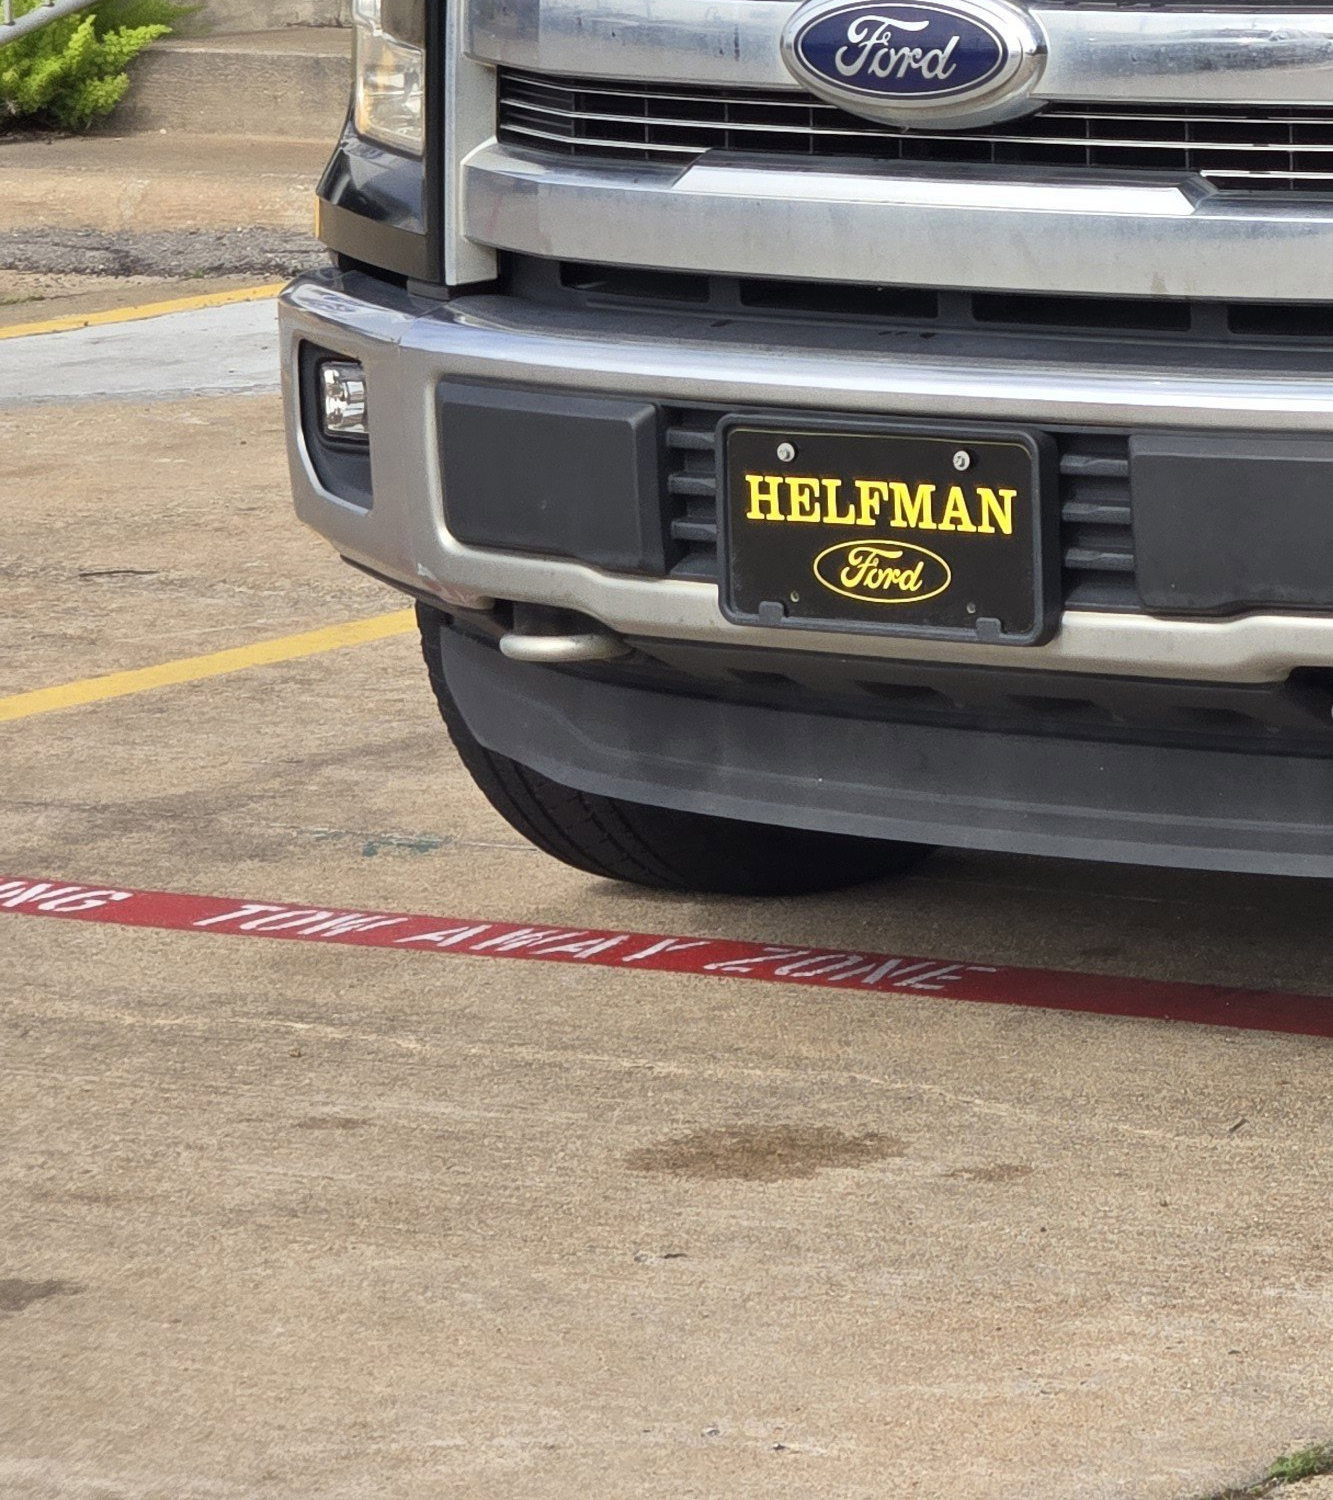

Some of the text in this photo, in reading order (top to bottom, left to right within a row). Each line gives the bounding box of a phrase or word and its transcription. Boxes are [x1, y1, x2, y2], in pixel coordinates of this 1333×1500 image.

[835, 14, 960, 80] Ford
[745, 474, 1017, 535] HELFMAN
[840, 546, 924, 592] Ford
[193, 904, 409, 938] TOW
[395, 923, 711, 963] AWAY
[701, 947, 998, 991] ZONE
